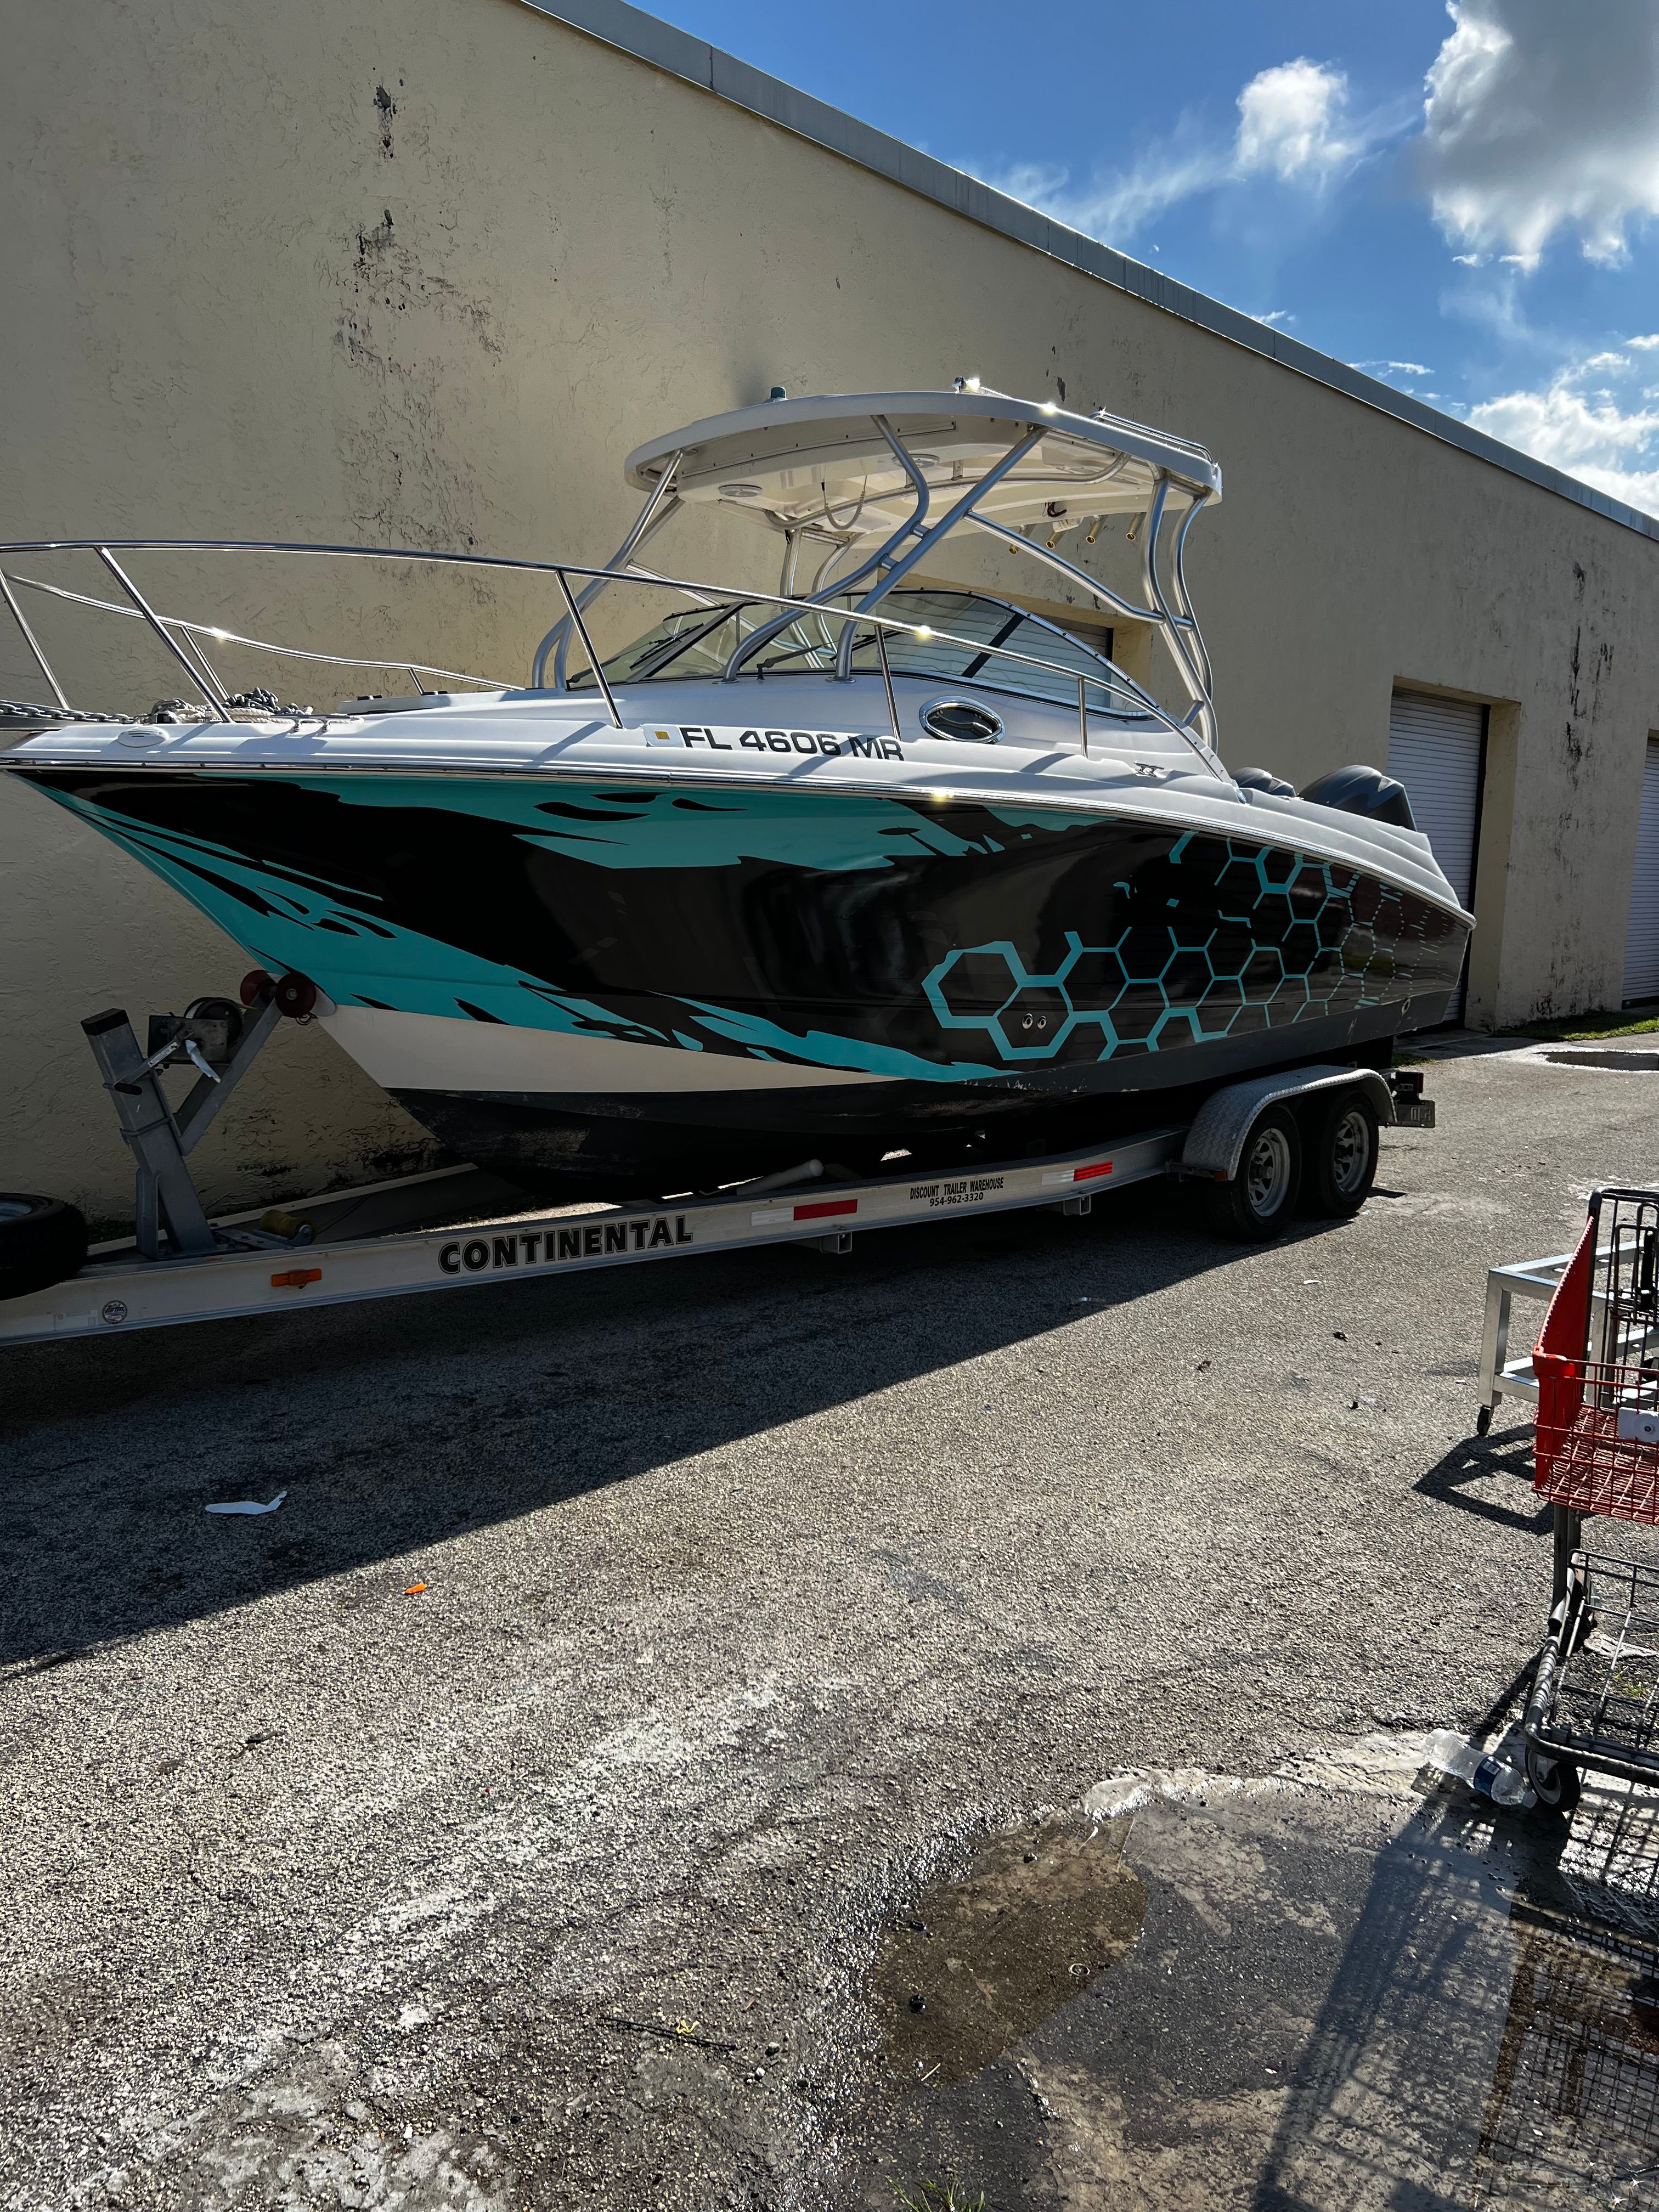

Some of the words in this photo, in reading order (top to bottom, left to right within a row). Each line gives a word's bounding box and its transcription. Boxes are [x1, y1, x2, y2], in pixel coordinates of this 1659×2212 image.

[679, 727, 732, 751] FL
[739, 730, 842, 755] 4606
[847, 735, 905, 761] MR
[910, 1184, 940, 1200] DISCOUNT
[944, 1181, 967, 1196] TRAILER
[969, 1177, 1004, 1192] WAREHOUSE
[929, 1192, 984, 1207] 954-962-3320
[438, 1215, 693, 1274] CONTINENTAL
